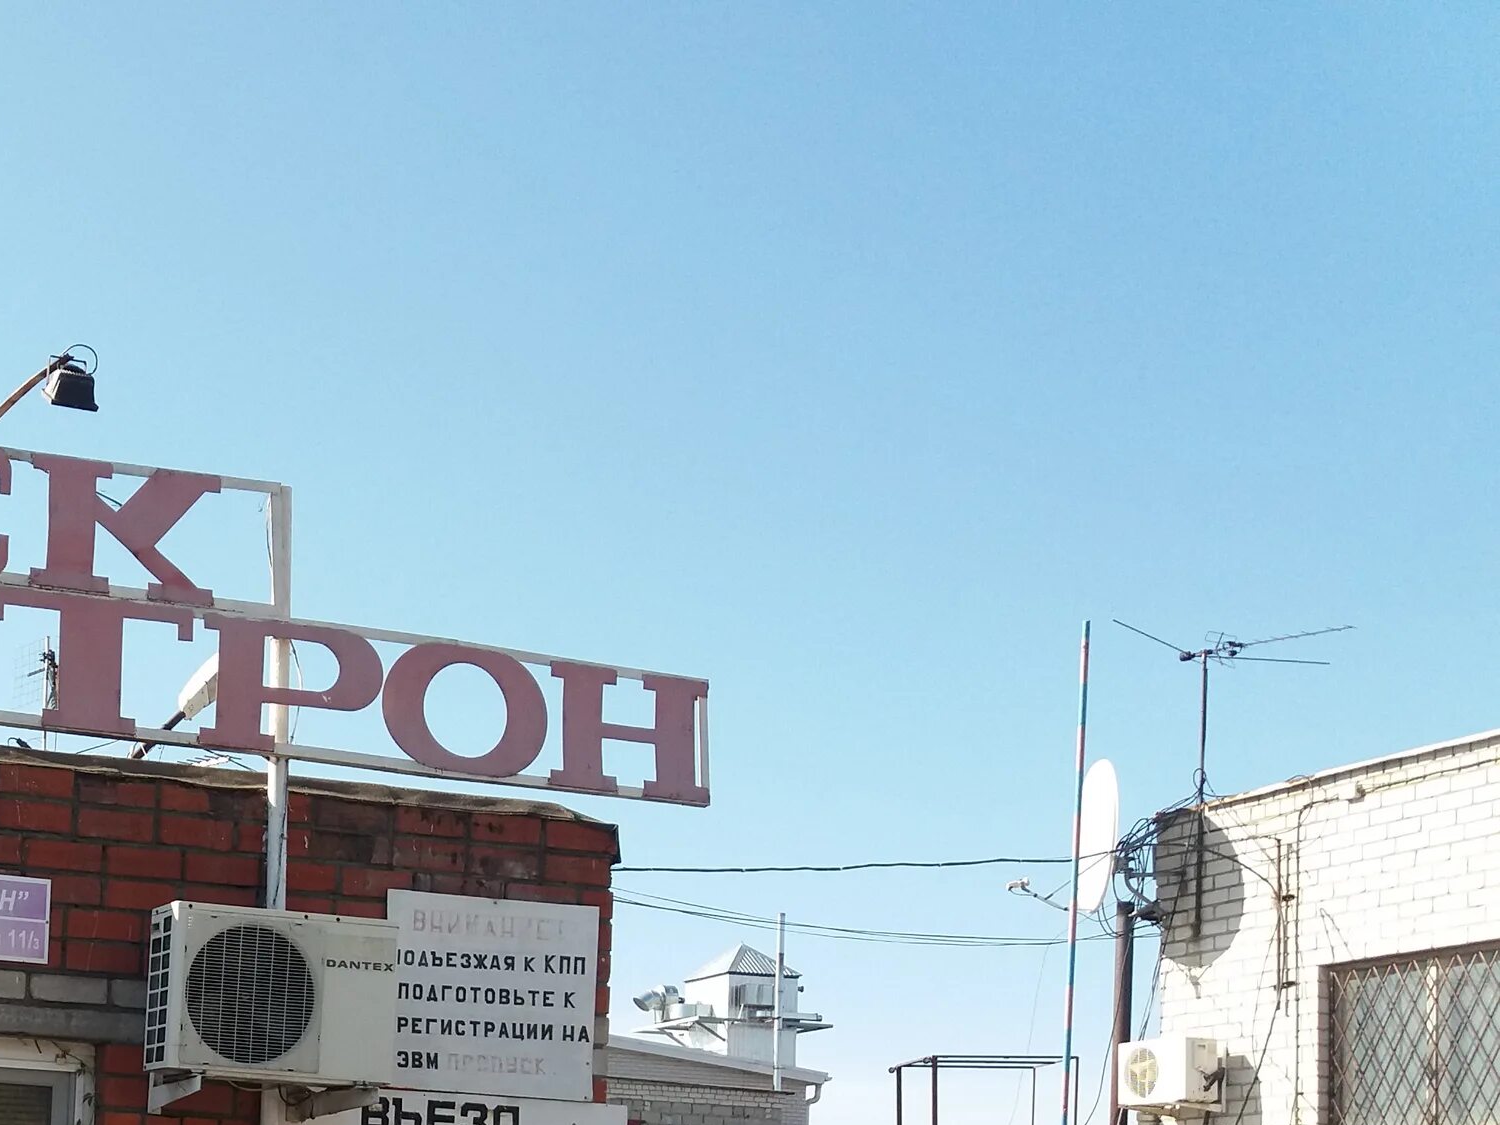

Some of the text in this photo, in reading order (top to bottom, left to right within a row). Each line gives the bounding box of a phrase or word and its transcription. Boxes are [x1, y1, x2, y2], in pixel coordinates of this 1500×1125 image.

[326, 959, 394, 972] DANTEX
[544, 955, 586, 976] КПП
[398, 982, 577, 1009] ПОДГОТОВЬТЕ К
[396, 1016, 590, 1043] РЕГИСТРАЦИИ НА
[397, 1050, 439, 1070] ЭВМ
